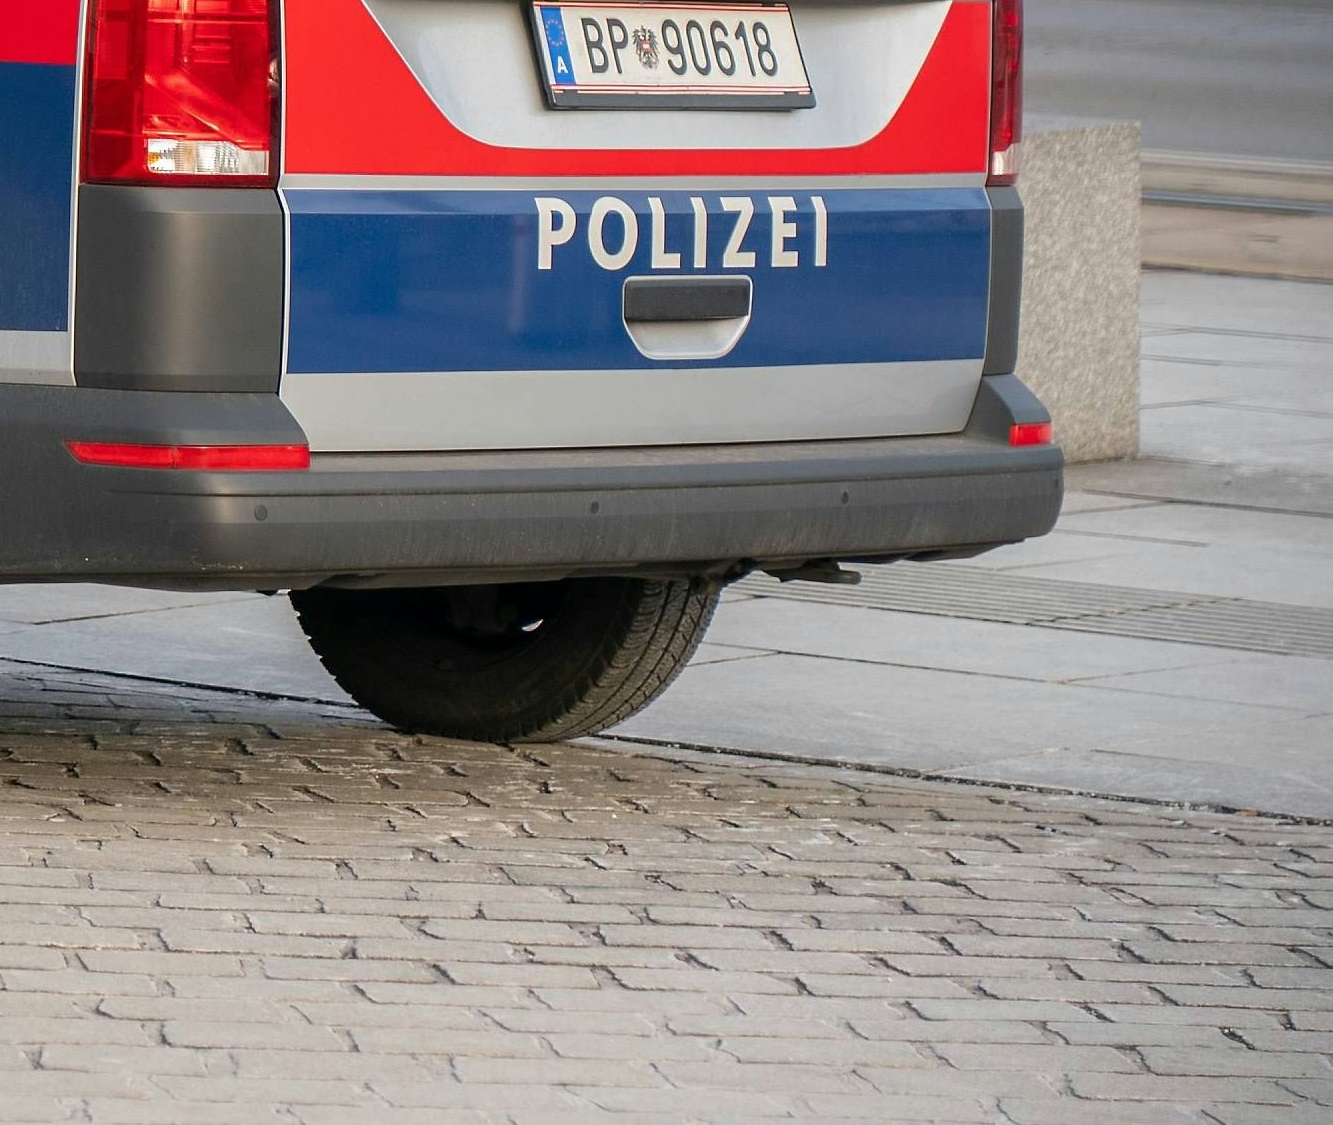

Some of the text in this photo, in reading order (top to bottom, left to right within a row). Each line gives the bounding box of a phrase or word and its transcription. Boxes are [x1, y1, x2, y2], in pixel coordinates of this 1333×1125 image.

[556, 56, 569, 74] A
[580, 17, 779, 77] BP 90618
[534, 196, 828, 271] POLIZEI
